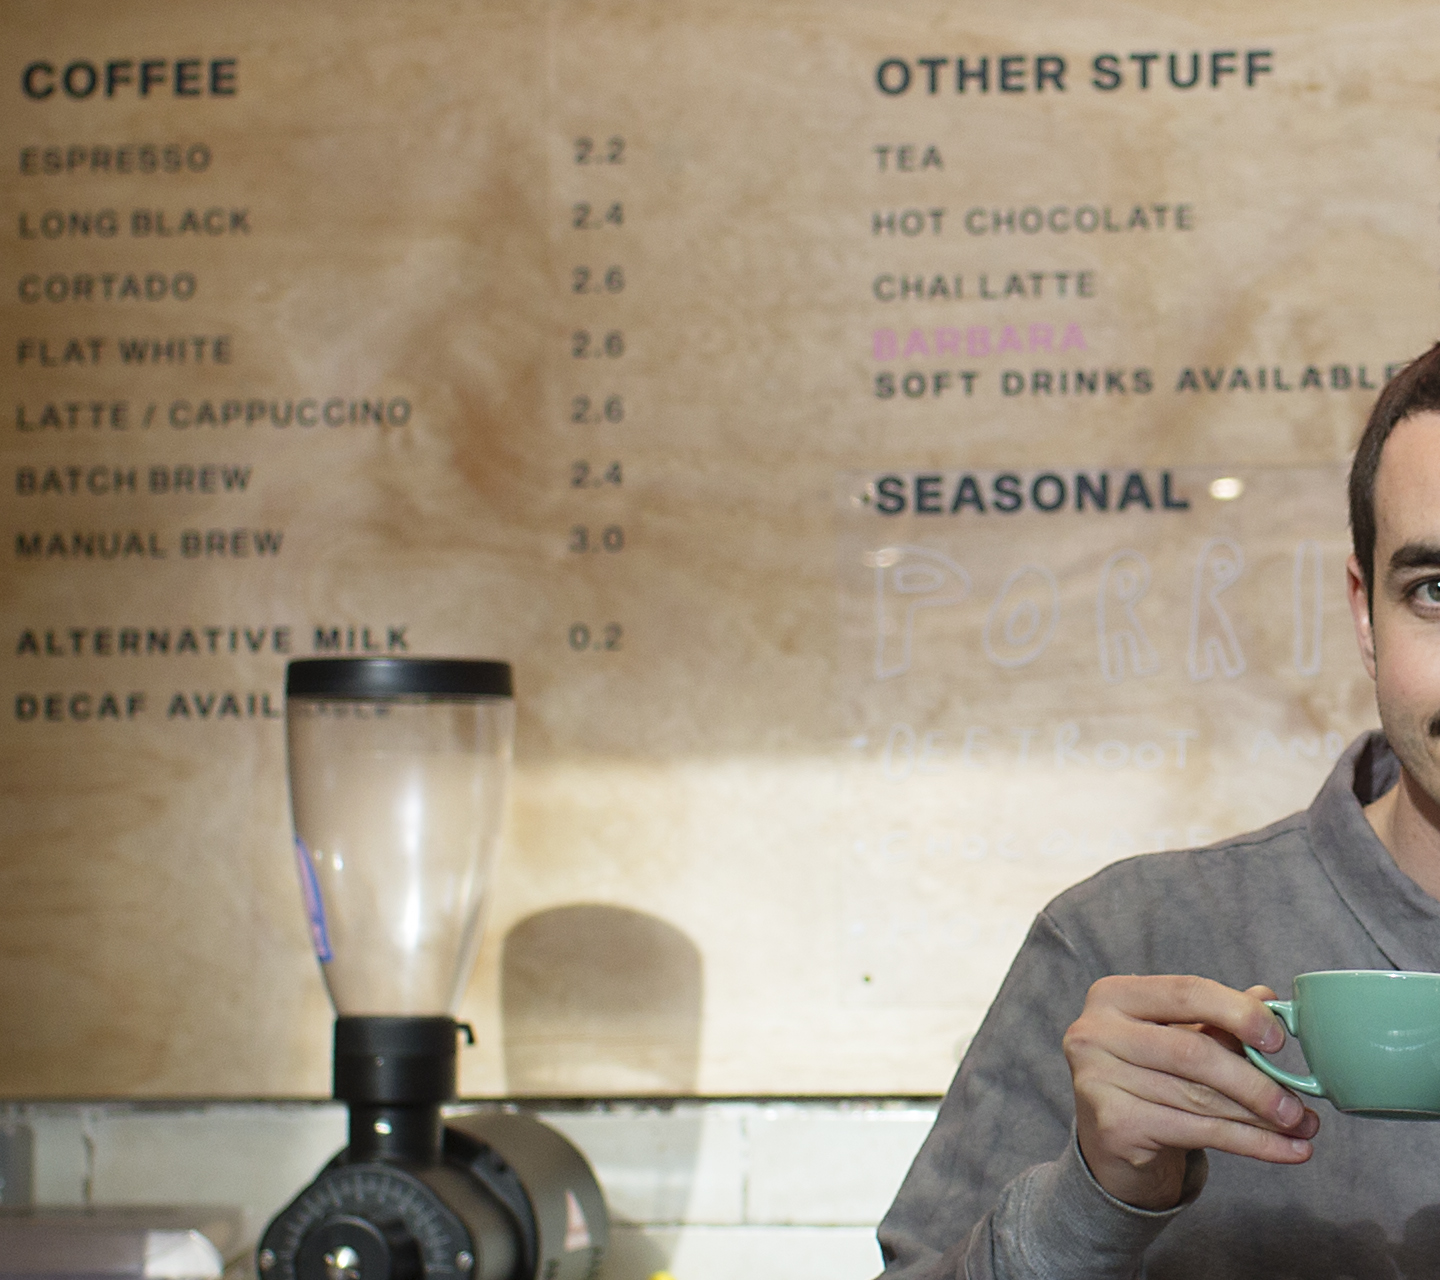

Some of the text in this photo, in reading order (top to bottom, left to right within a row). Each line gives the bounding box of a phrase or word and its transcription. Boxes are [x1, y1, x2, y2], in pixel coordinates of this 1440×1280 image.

[21, 57, 239, 101] COFFEE
[875, 50, 1276, 96] OTHER STUFF
[20, 137, 625, 175] ESPRESSO 2.2
[875, 146, 944, 173] TEA
[18, 202, 624, 240] LONG BLACK 2.4
[872, 208, 946, 236] HOT
[965, 204, 1194, 234] CHOCOLATE
[18, 267, 624, 304] CORTADO 2.6
[872, 273, 967, 301] CHAI
[977, 271, 1096, 299] LATTE
[17, 331, 624, 367] FLAT WHITE 2.6
[871, 323, 1088, 361] BARBARA
[873, 371, 977, 400] SOFT
[1000, 368, 1153, 398] DRINKS
[16, 396, 624, 433] LATTE CAPPUCCINO 2.6
[16, 461, 623, 495] BATCH BREW 2.4
[875, 471, 1191, 516] SEASONAL
[16, 525, 624, 559] MANUAL BREW 3.0
[875, 535, 1325, 685] PORRI
[16, 623, 624, 657] ALTERNATIVE MILK 0.2
[15, 692, 147, 722] DECAF
